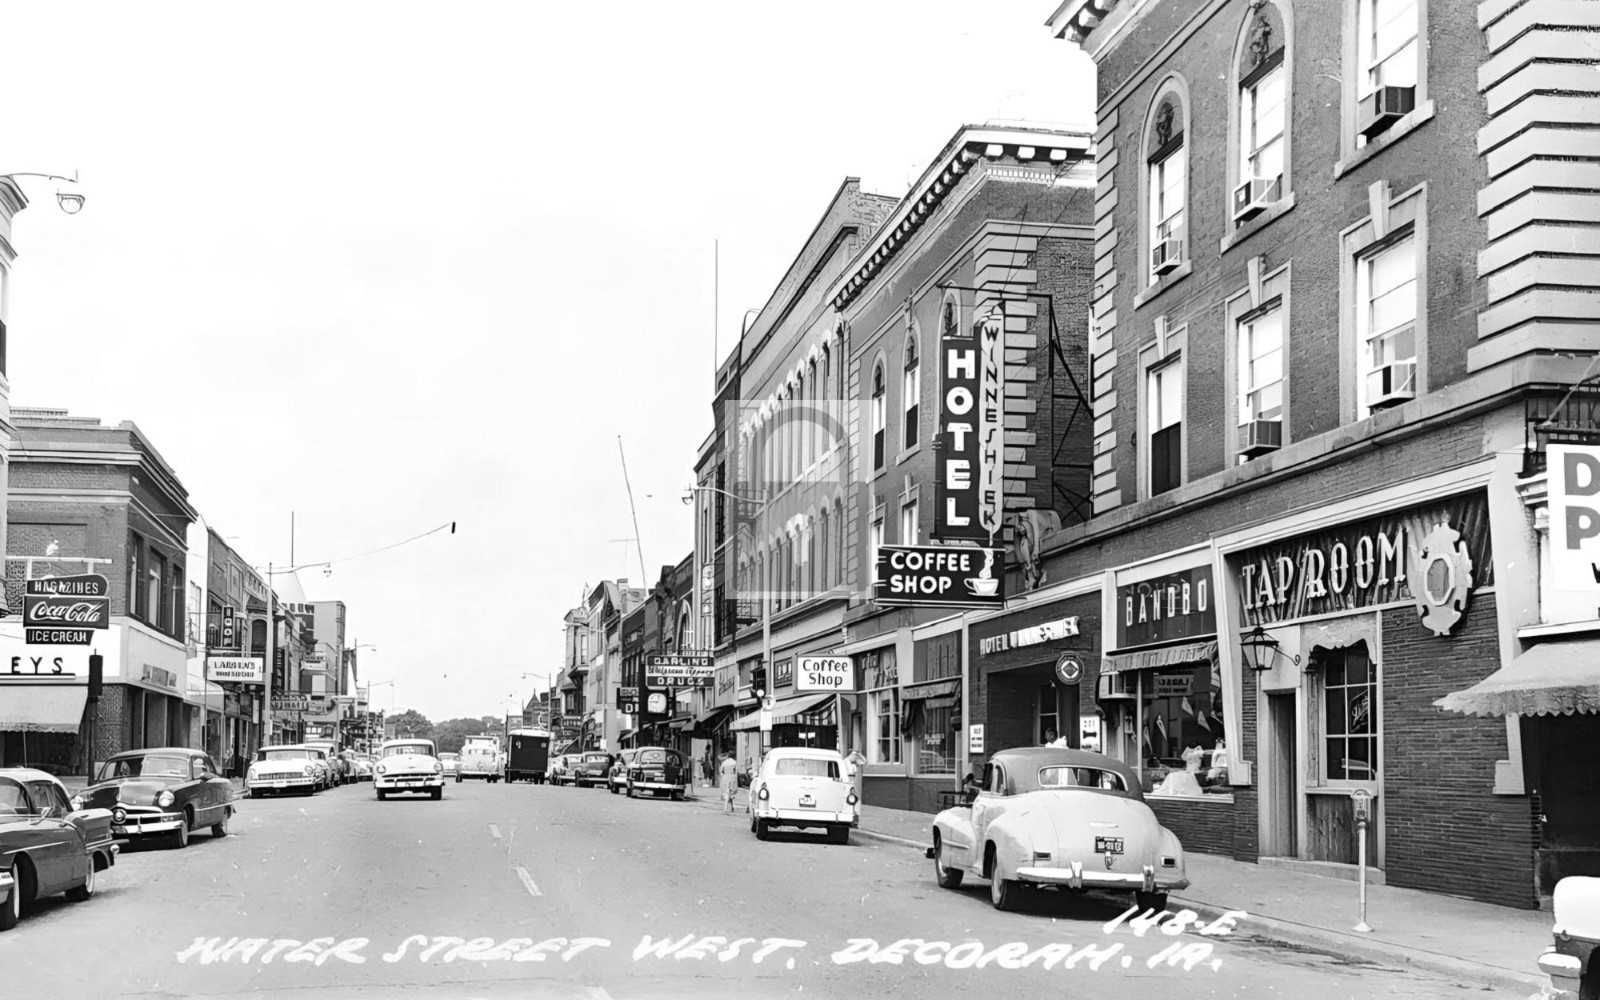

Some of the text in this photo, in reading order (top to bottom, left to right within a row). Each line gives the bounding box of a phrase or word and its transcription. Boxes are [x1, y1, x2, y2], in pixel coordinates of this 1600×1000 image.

[983, 325, 999, 526] WINNESHIEK
[946, 348, 976, 527] HOTEL
[890, 551, 971, 572] COFFEE
[890, 575, 952, 594] SHOP
[31, 630, 87, 642] ICE CREAM
[803, 659, 848, 672] Coffee
[808, 672, 843, 688] Shop
